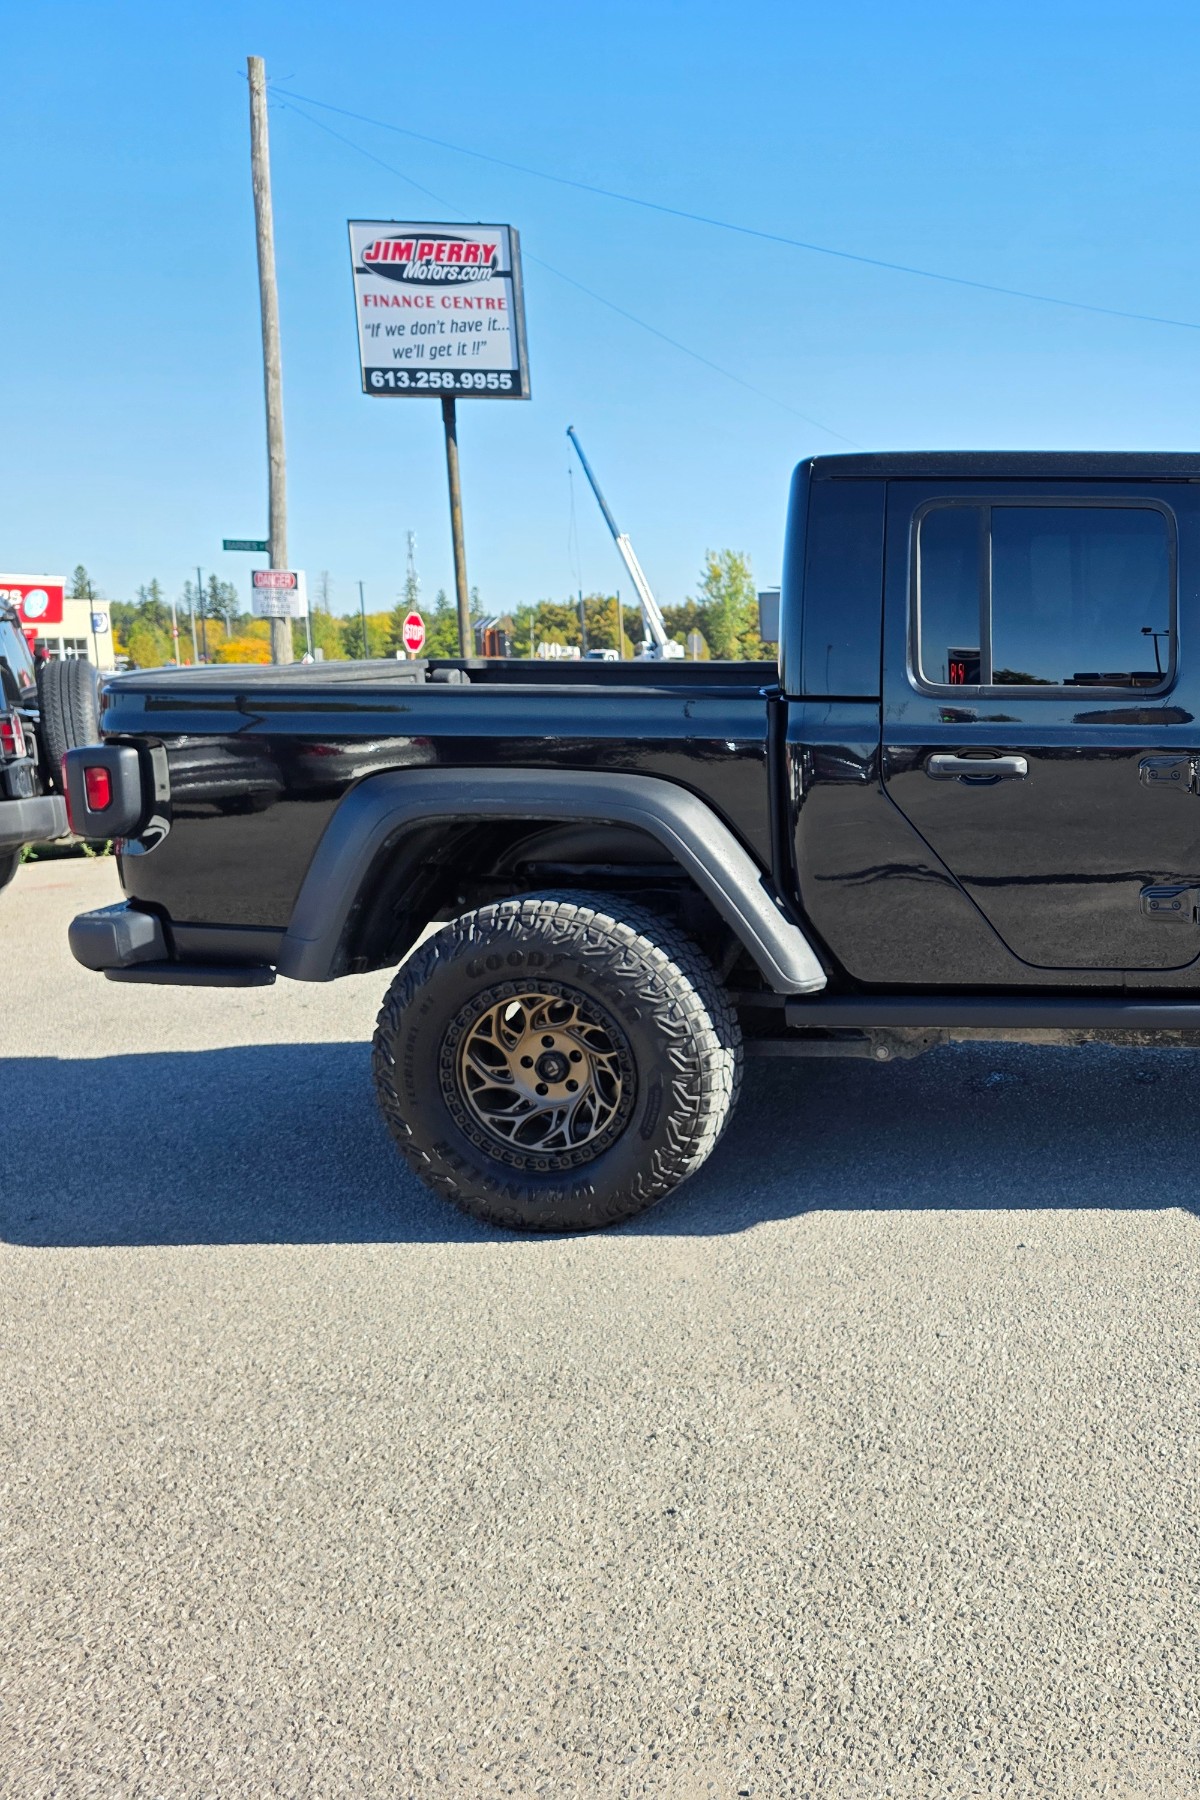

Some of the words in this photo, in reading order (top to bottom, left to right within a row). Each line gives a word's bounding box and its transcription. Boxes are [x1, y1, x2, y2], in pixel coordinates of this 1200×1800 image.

[364, 240, 414, 262] JIM
[417, 241, 498, 264] PERRY
[402, 261, 493, 281] Motors.com
[363, 294, 436, 309] FINANCE
[441, 296, 508, 311] CENTRE
[385, 325, 406, 336] we
[410, 320, 445, 336] don't
[450, 318, 483, 333] have
[392, 343, 425, 359] we'll
[429, 344, 452, 360] get
[457, 342, 467, 356] it
[370, 370, 513, 390] 613.258.9955
[256, 573, 291, 588] DANGER
[405, 624, 424, 640] STOP
